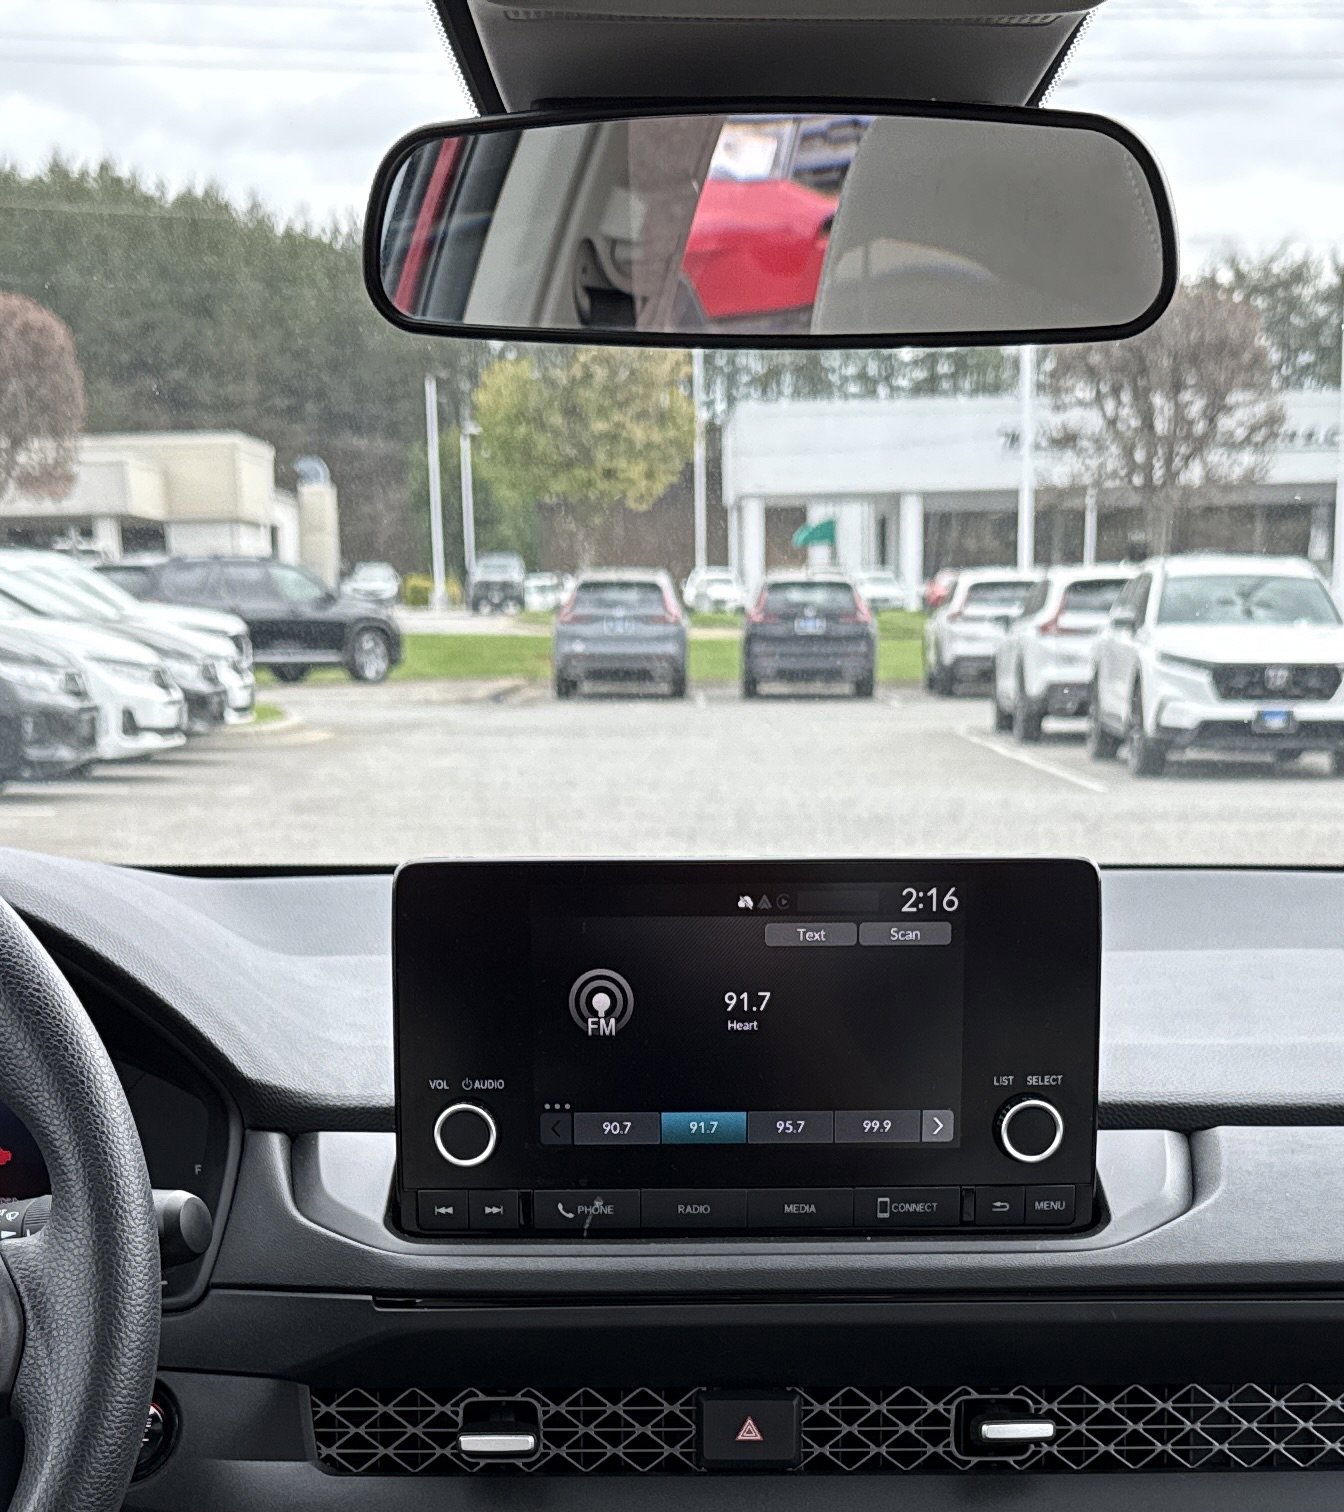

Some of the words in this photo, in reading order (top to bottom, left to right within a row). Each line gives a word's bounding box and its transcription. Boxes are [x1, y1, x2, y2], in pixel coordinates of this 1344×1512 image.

[901, 887, 959, 912] 2:16
[796, 928, 826, 942] Text
[890, 927, 921, 941] Scan
[724, 991, 771, 1012] 91.7
[587, 1017, 616, 1036] FM
[727, 1019, 759, 1031] Heart
[428, 1079, 450, 1090] VOL
[473, 1079, 505, 1090] AUDIO
[993, 1075, 1015, 1086] LIST
[1026, 1074, 1064, 1086] SELECT
[602, 1121, 632, 1135] 90.7
[689, 1121, 719, 1134] 91.7
[776, 1120, 806, 1134] 95.7
[862, 1119, 892, 1133] 99.9
[194, 1164, 202, 1175] F
[577, 1203, 614, 1215] PHONE
[677, 1204, 711, 1215] RADIO
[784, 1203, 817, 1214] MEDIA
[891, 1201, 938, 1213] CONNECT
[1034, 1200, 1066, 1211] MENU
